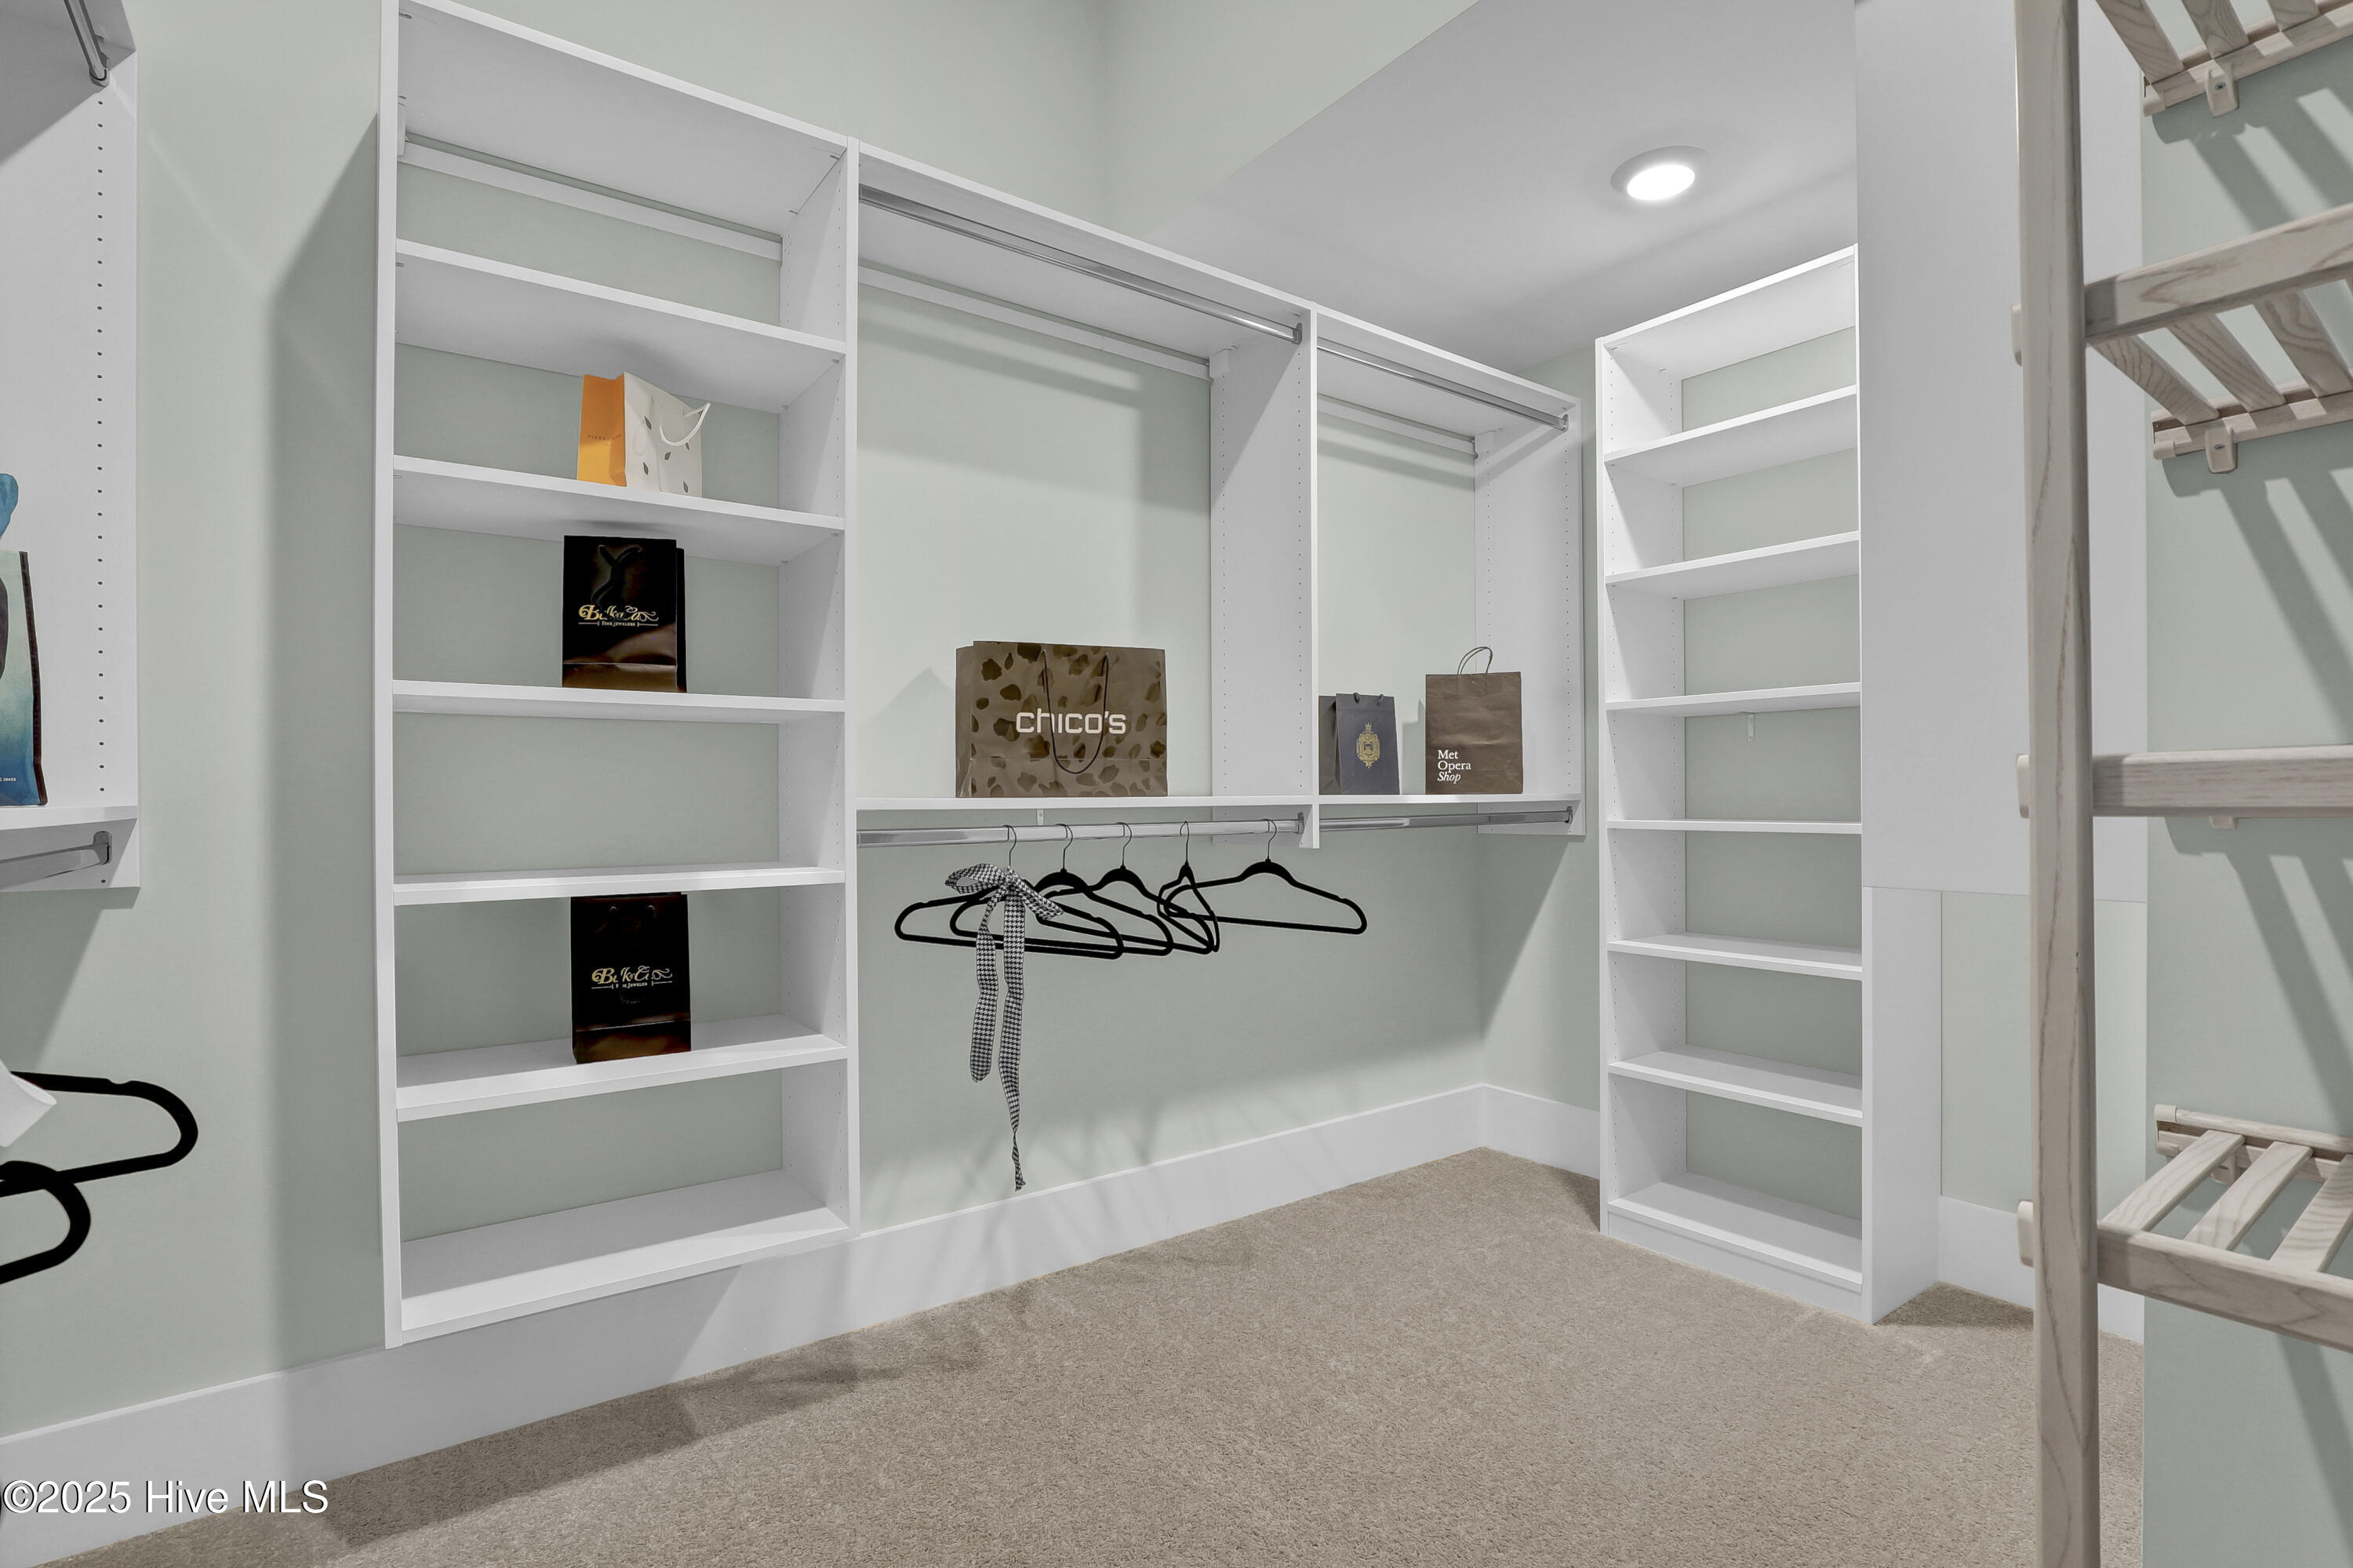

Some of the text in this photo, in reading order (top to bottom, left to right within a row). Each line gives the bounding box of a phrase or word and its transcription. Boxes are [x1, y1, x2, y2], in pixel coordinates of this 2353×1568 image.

[1016, 708, 1126, 734] chico's
[1437, 749, 1459, 759] Met
[1437, 760, 1472, 773] Opera
[1437, 771, 1461, 784] Shop
